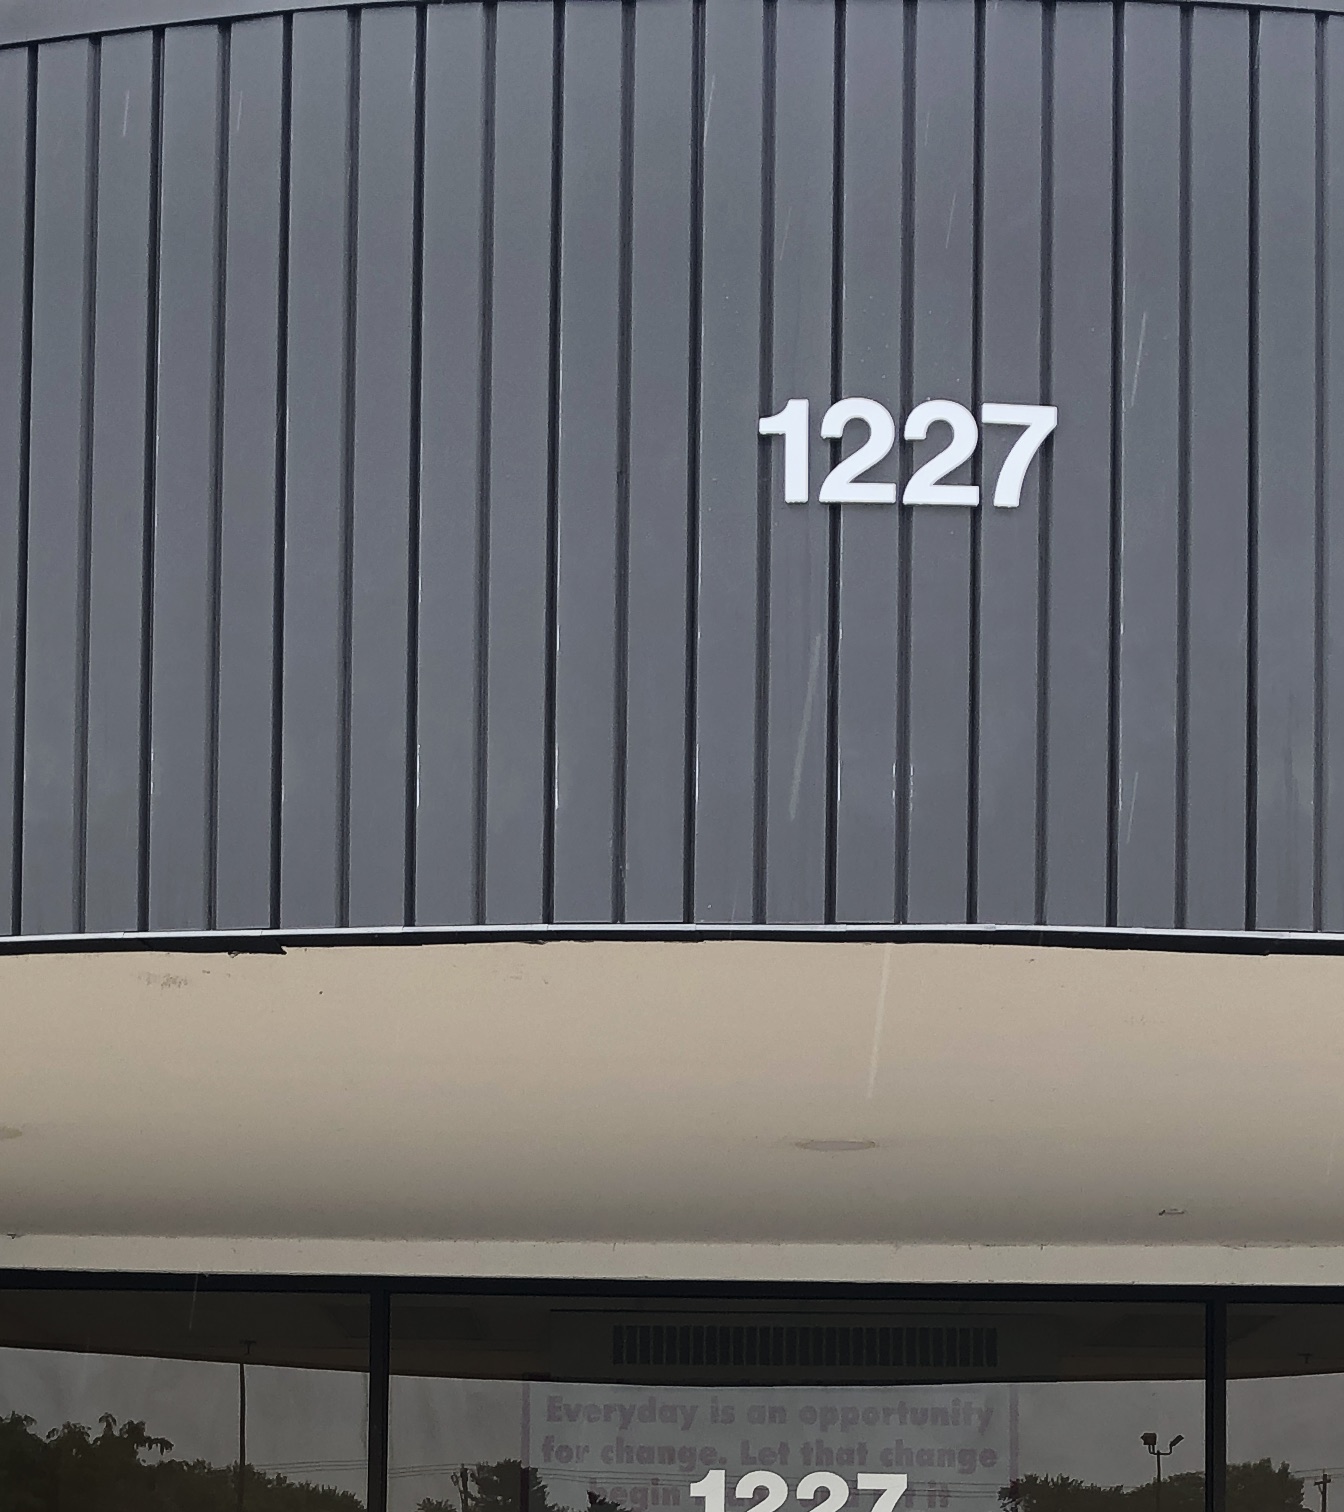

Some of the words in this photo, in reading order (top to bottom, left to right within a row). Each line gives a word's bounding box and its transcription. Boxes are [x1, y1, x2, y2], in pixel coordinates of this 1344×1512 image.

[759, 397, 1057, 508] 1227
[546, 1395, 698, 1431] Everyday
[710, 1395, 735, 1425] is
[747, 1405, 787, 1424] an
[799, 1397, 994, 1435] opportunity
[542, 1435, 590, 1463] for
[601, 1436, 727, 1472] change.
[740, 1439, 790, 1466] Let
[800, 1439, 868, 1466] that
[879, 1439, 997, 1475] change
